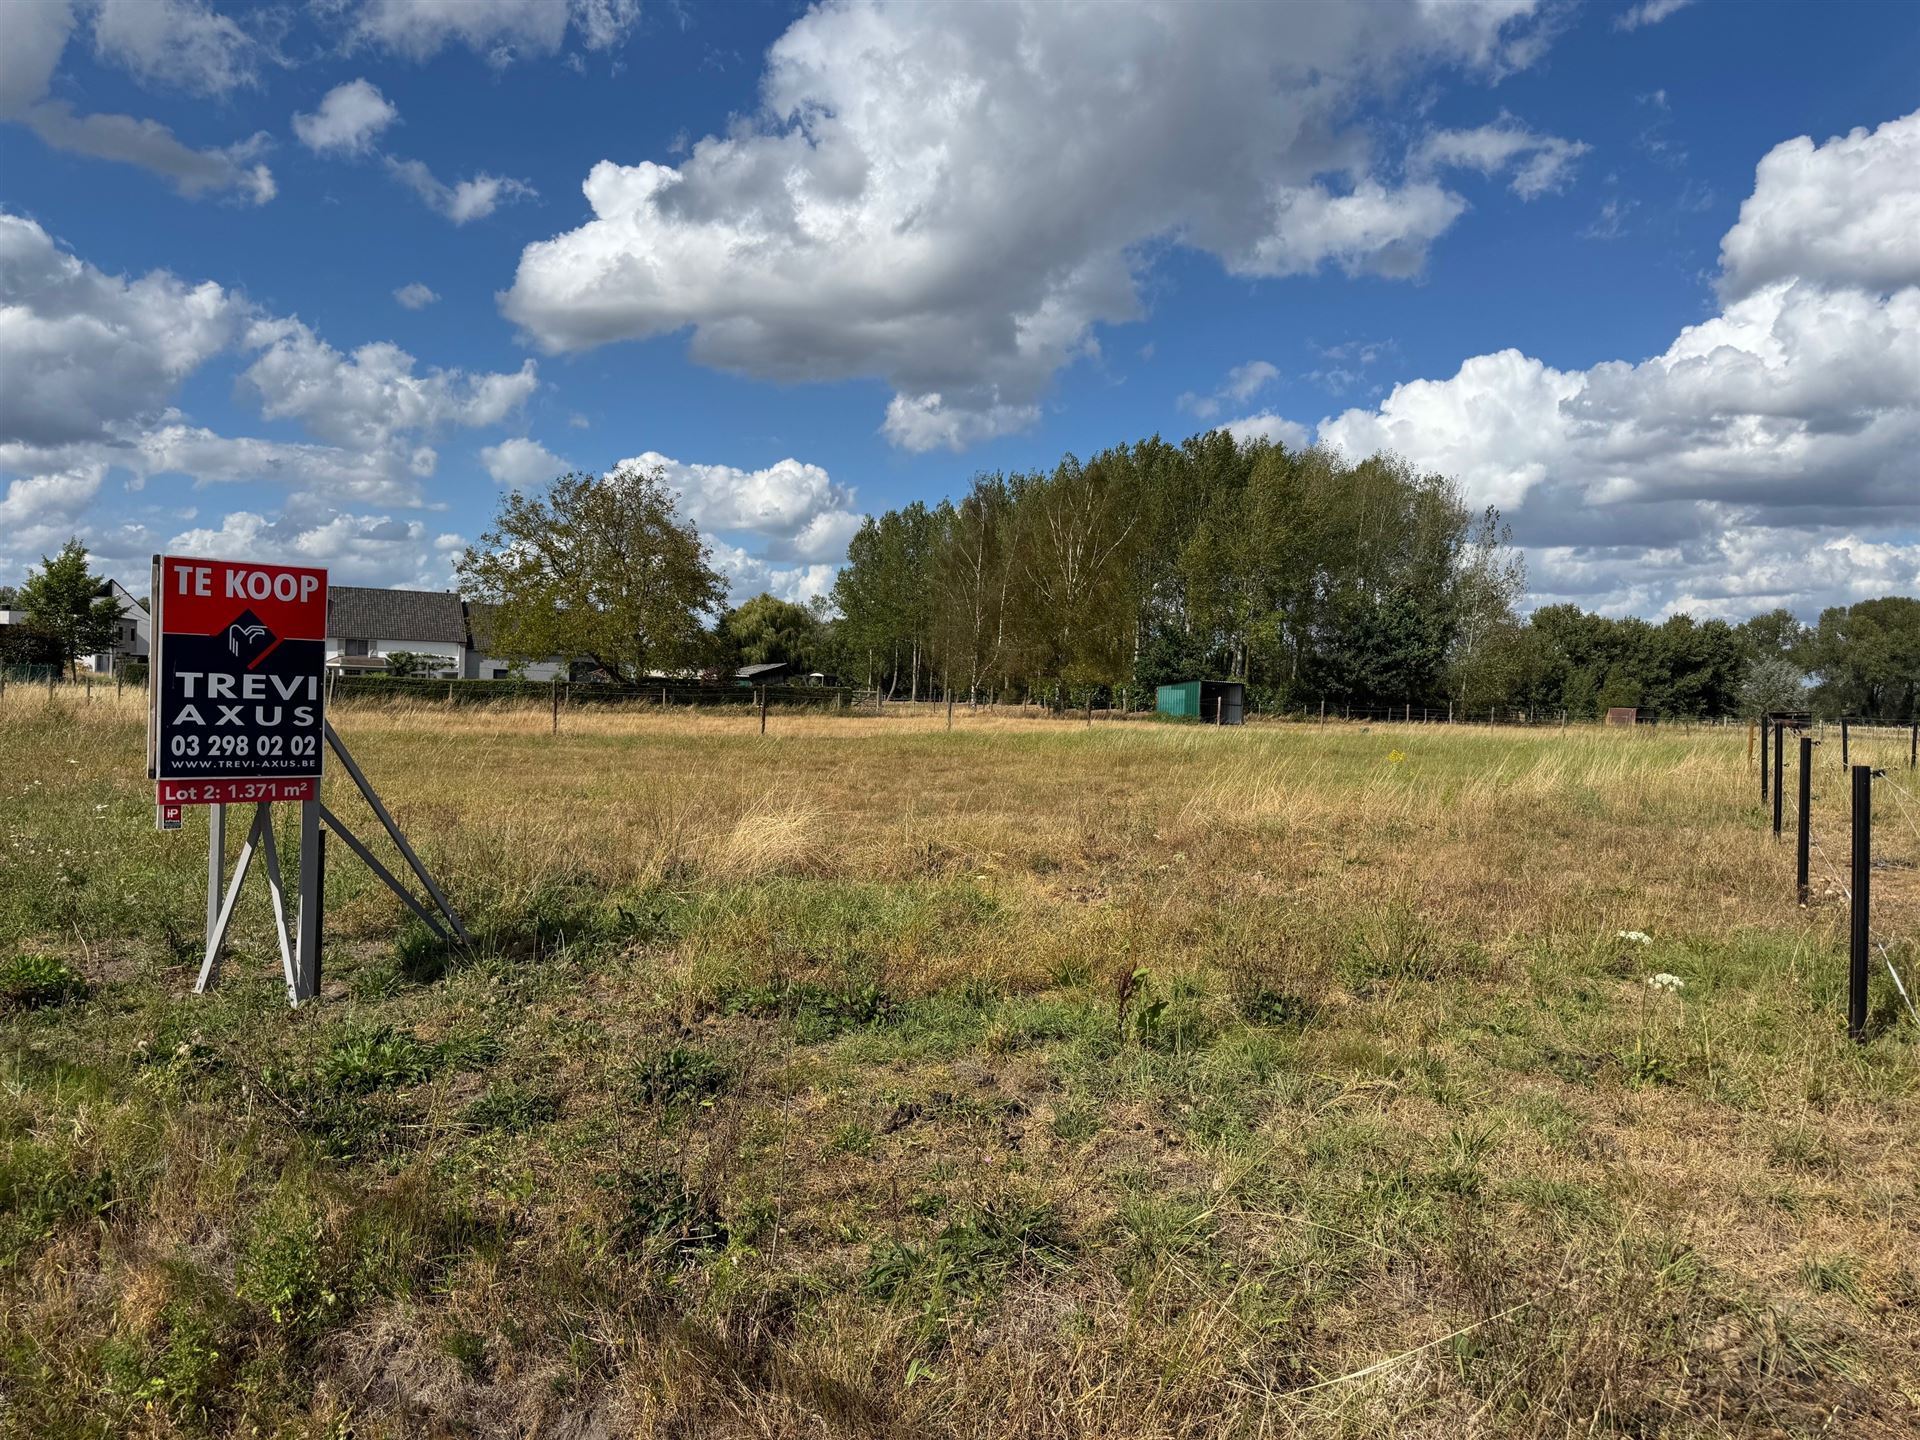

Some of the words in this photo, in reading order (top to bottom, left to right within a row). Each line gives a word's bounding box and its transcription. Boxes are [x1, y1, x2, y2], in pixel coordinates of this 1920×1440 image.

[174, 565, 212, 597] TE
[225, 569, 319, 603] KOOP
[175, 672, 317, 701] TREVI
[172, 704, 314, 726] AXUS
[171, 735, 200, 756] 03
[207, 735, 249, 756] 298
[256, 735, 283, 756] 02
[290, 735, 316, 756] 02
[171, 760, 316, 768] WWW.TREVI-AXUS.BE
[165, 786, 197, 801] Lot
[203, 785, 221, 799] 2:
[227, 783, 277, 798] 1.371
